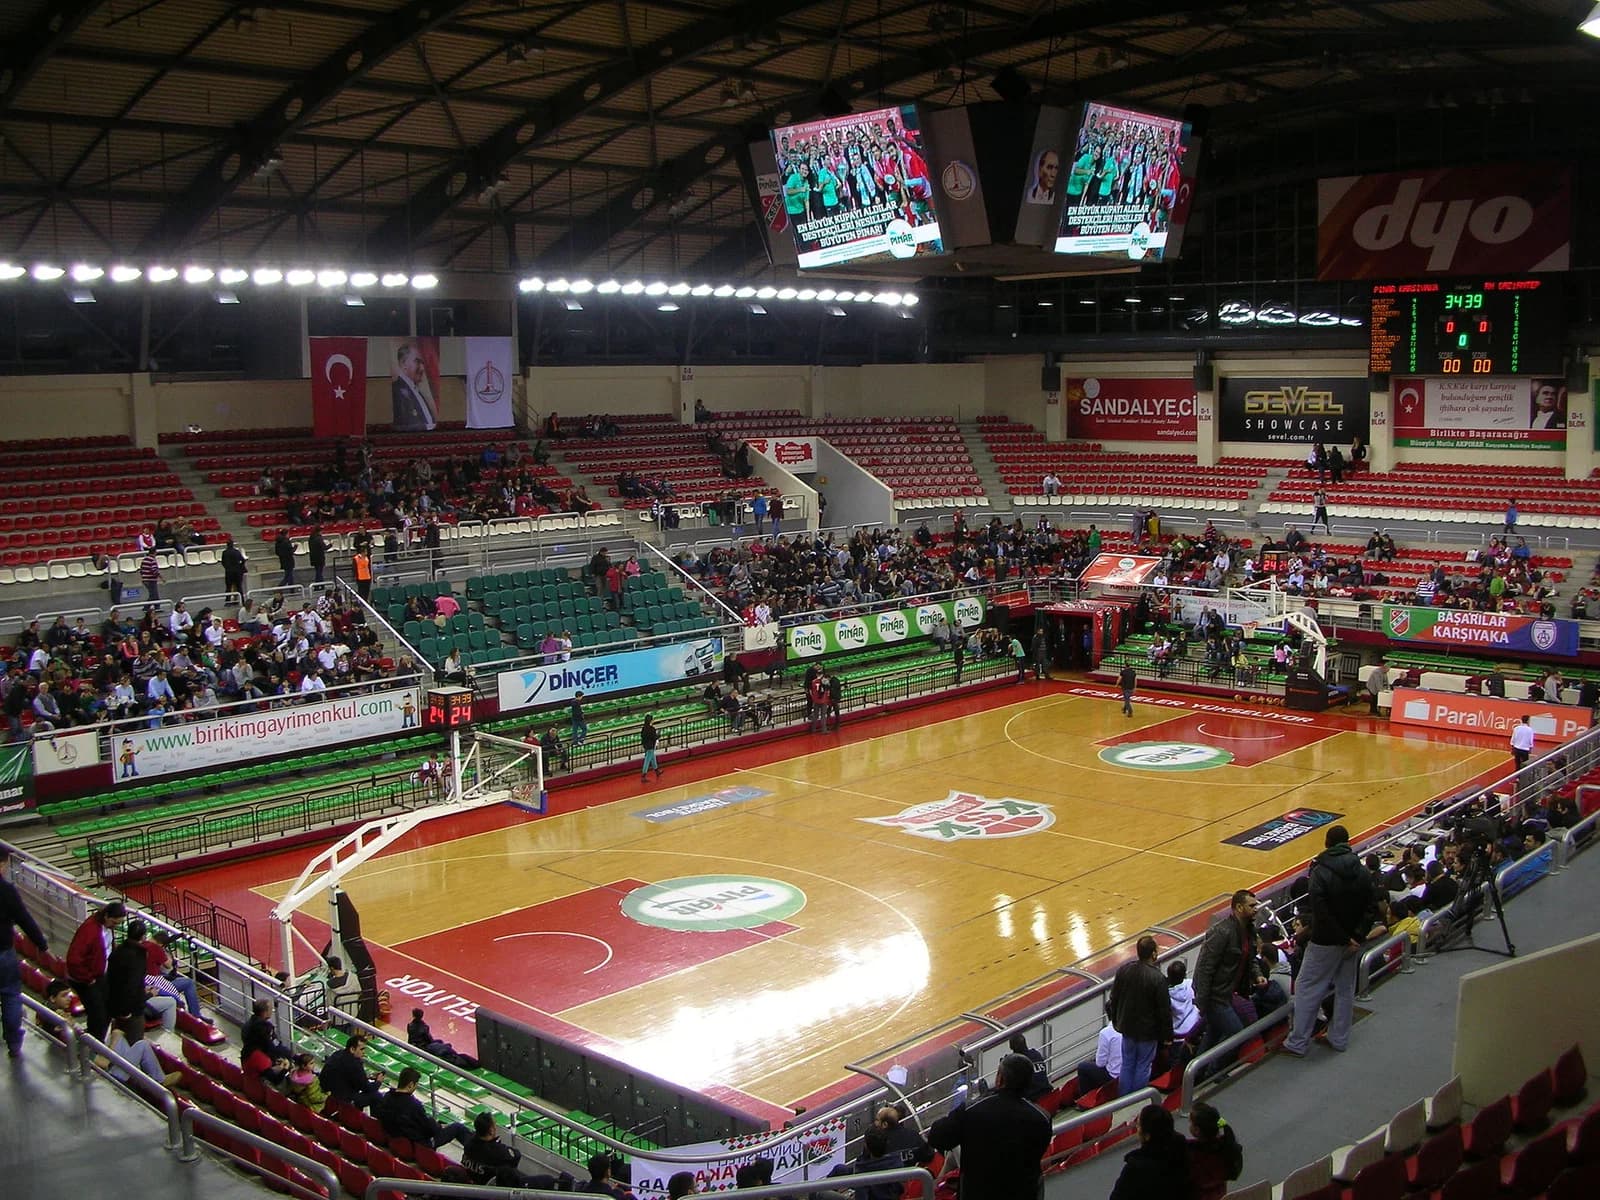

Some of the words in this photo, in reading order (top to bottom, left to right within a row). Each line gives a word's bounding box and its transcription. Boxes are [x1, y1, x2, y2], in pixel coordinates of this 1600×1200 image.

[797, 224, 807, 234] EN
[808, 216, 834, 230] BÜYÜK
[863, 201, 898, 217] ALDILAR
[856, 210, 896, 227] NESİLLERİ
[1352, 178, 1534, 271] dyo
[820, 230, 856, 247] BÜYÜTEN
[1443, 359, 1460, 372] 00
[1473, 359, 1491, 372] 00
[1245, 386, 1343, 416] SEVEL
[1246, 419, 1344, 431] SHOWCASE
[1430, 429, 1466, 438] Birlikte
[1468, 430, 1529, 440] Başaracağız
[957, 604, 979, 619] PINAR
[1438, 612, 1506, 628] BAŞARILAR
[839, 622, 864, 640] PINAR
[880, 616, 905, 633] PINAR
[795, 630, 822, 648] PINAR
[1433, 625, 1509, 644] KARŞIYAKA
[550, 664, 618, 691] DİNÇER
[430, 706, 444, 724] 24
[451, 706, 471, 724] 24
[145, 698, 393, 752] www.birikimgayrimenkul.com
